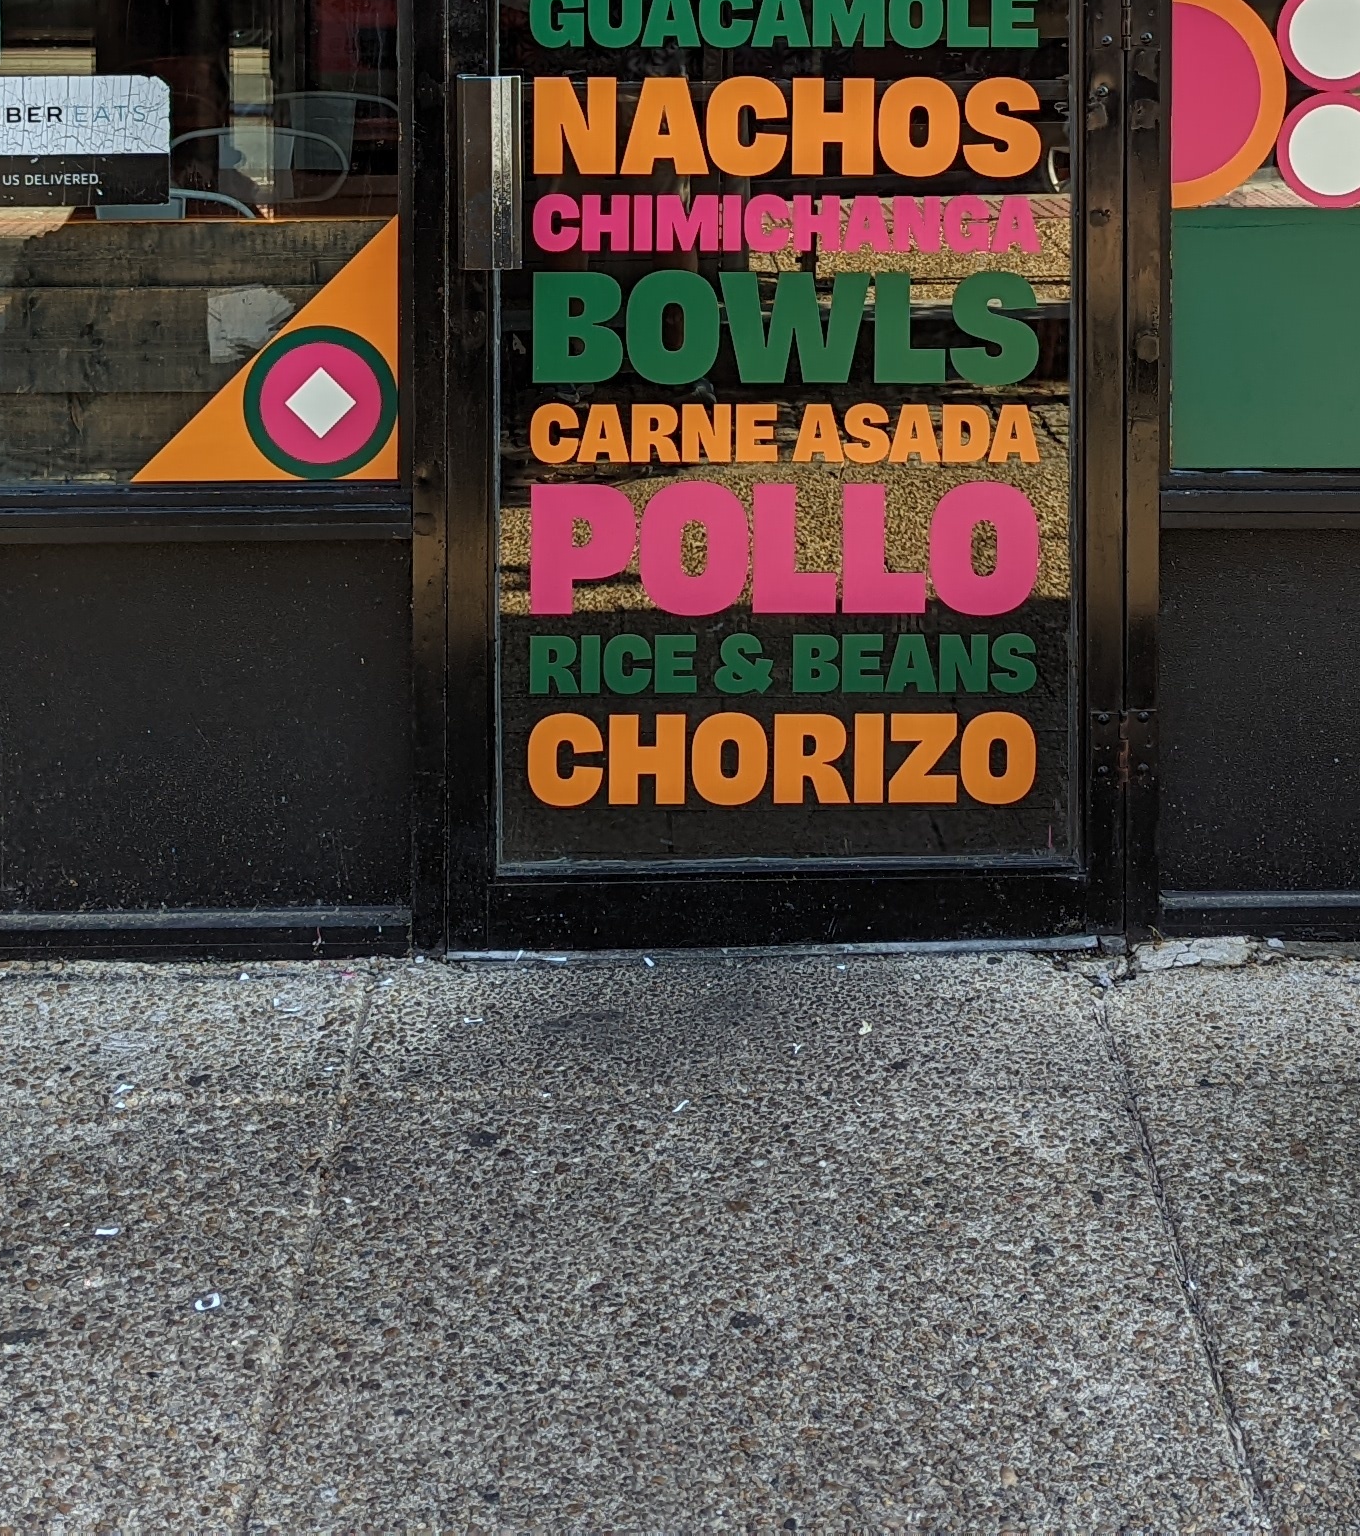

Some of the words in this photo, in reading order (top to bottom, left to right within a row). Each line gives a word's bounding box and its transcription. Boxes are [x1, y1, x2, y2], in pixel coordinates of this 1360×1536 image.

[74, 105, 147, 123] EATS
[532, 76, 1042, 177] NACHOS
[2, 175, 20, 185] US
[24, 173, 103, 185] DELIVERED.
[532, 193, 1041, 253] CHIMICHANGA
[532, 269, 1041, 385] BOWLS
[530, 403, 778, 464] CARNE
[795, 403, 1040, 464] ASADA
[529, 481, 1040, 616] POLLO
[528, 634, 697, 694] RICE
[714, 633, 774, 696] &
[793, 633, 1038, 694] BEANS
[527, 712, 1037, 807] CHORIZO
